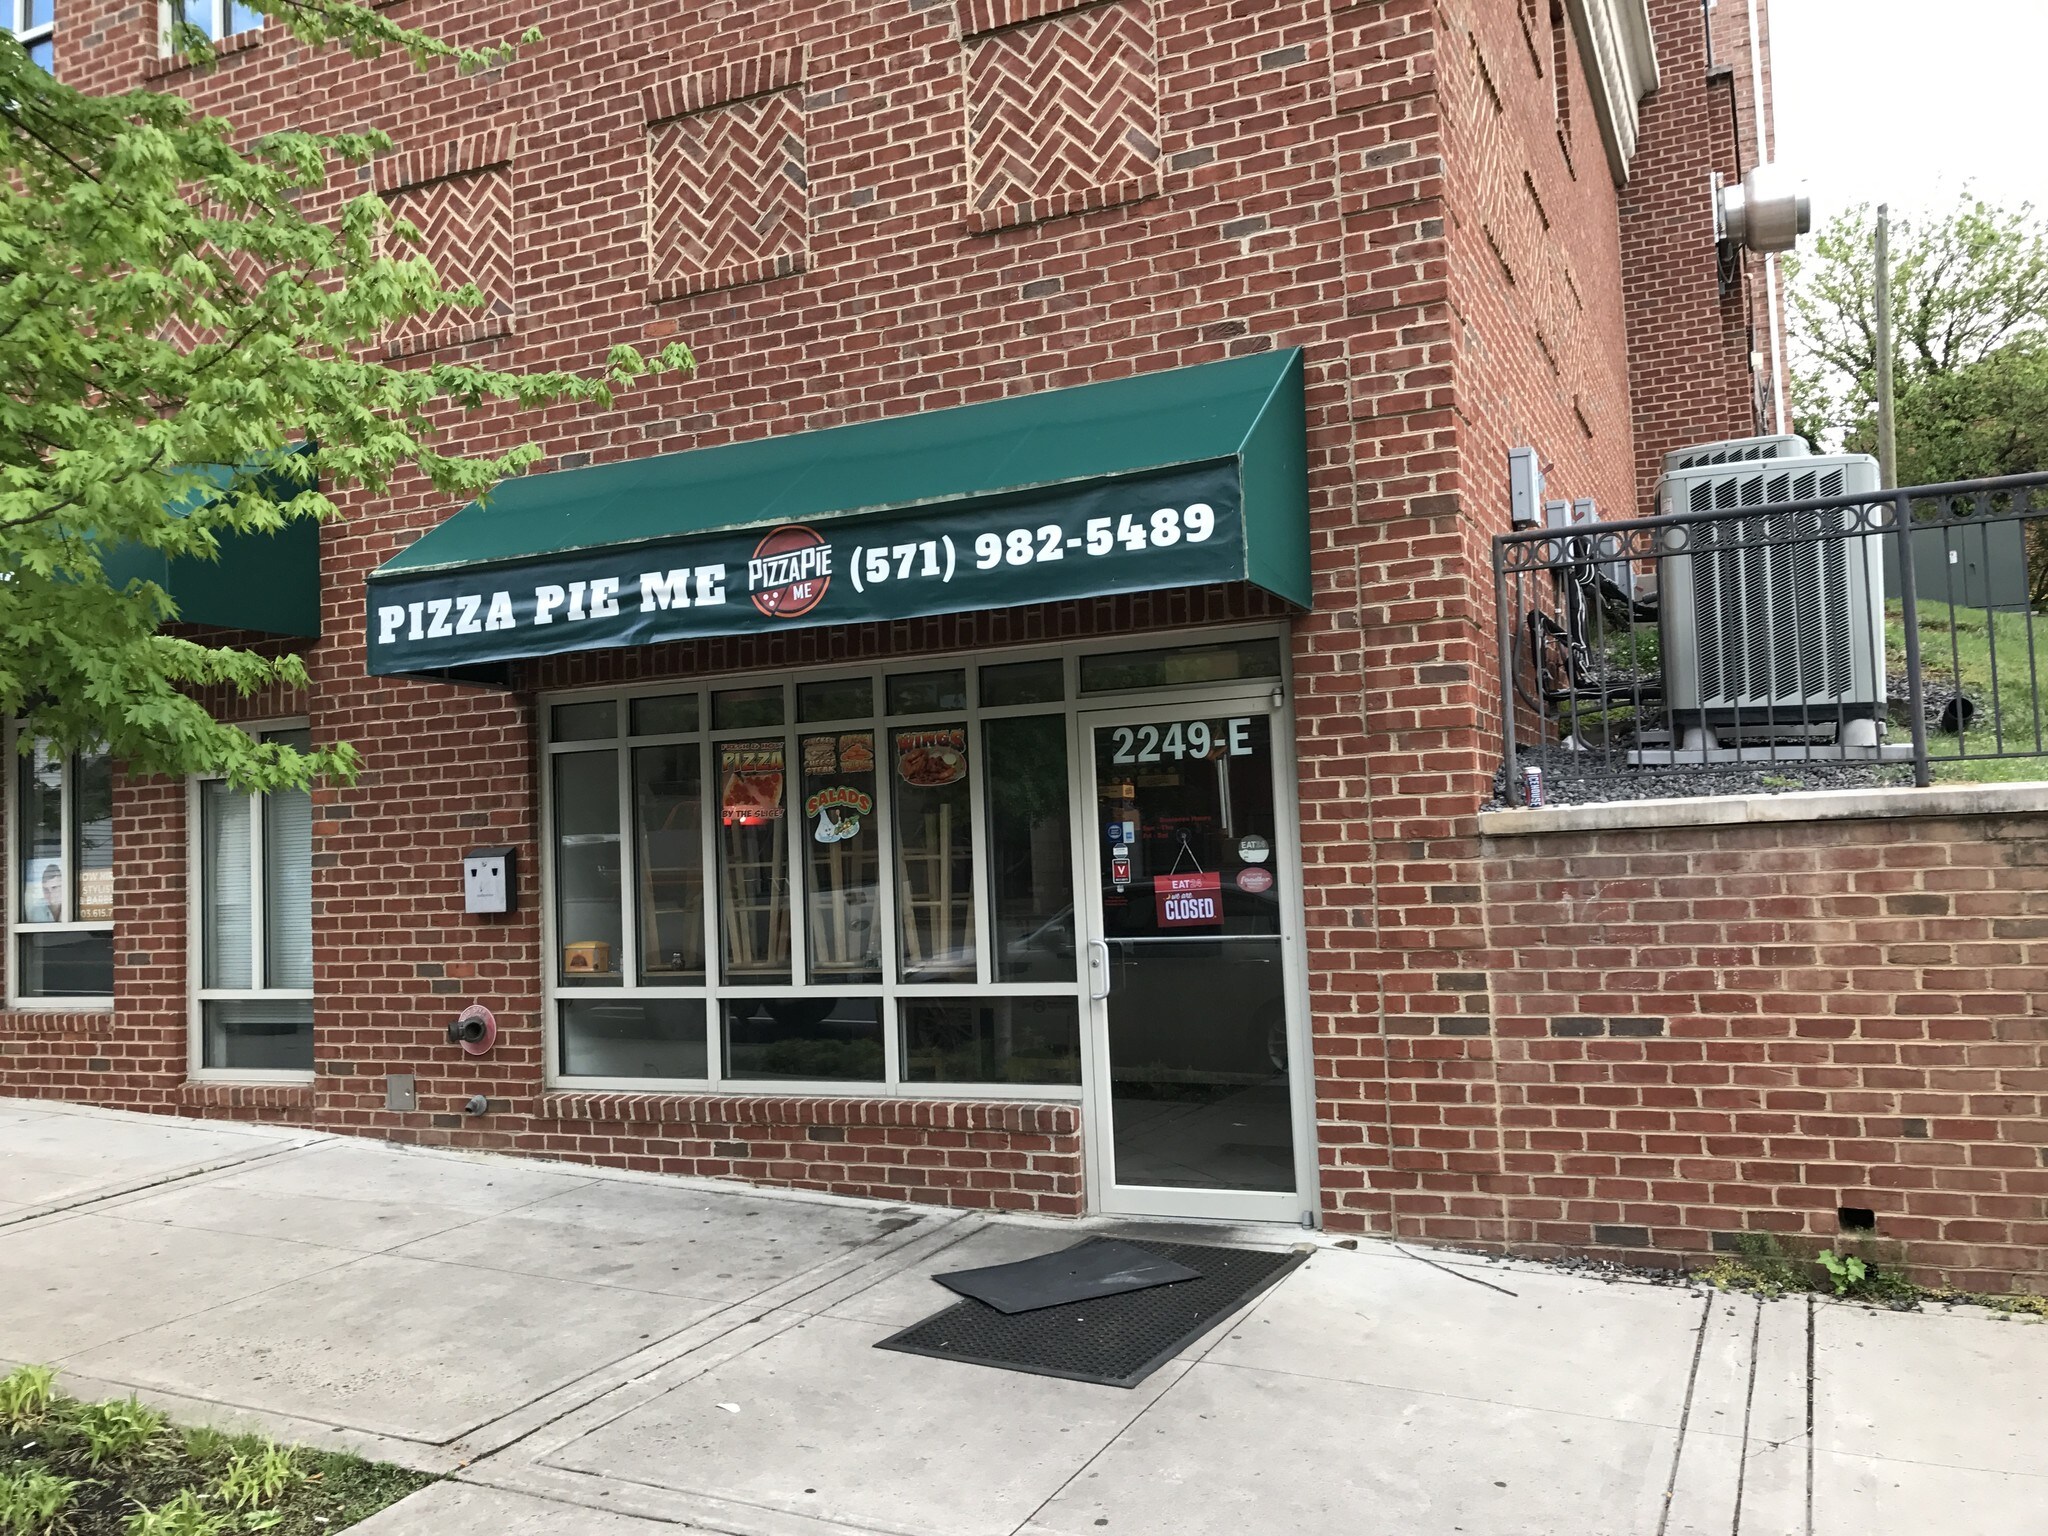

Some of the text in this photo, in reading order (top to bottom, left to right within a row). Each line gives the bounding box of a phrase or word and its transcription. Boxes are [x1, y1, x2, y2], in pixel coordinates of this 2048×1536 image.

[850, 503, 1215, 593] (571) 982-5489
[378, 563, 726, 644] PIZZA PIE ME
[793, 583, 812, 600] ME
[896, 729, 966, 754] WINGS
[1112, 718, 1252, 764] 2249-E
[722, 752, 784, 772] PIZZA
[805, 767, 836, 775] STEAK
[807, 788, 870, 814] SALADS
[1527, 774, 1542, 807] ICEHOUSE
[722, 810, 734, 818] BY
[736, 809, 752, 817] THE
[1165, 898, 1215, 920] CLOSED
